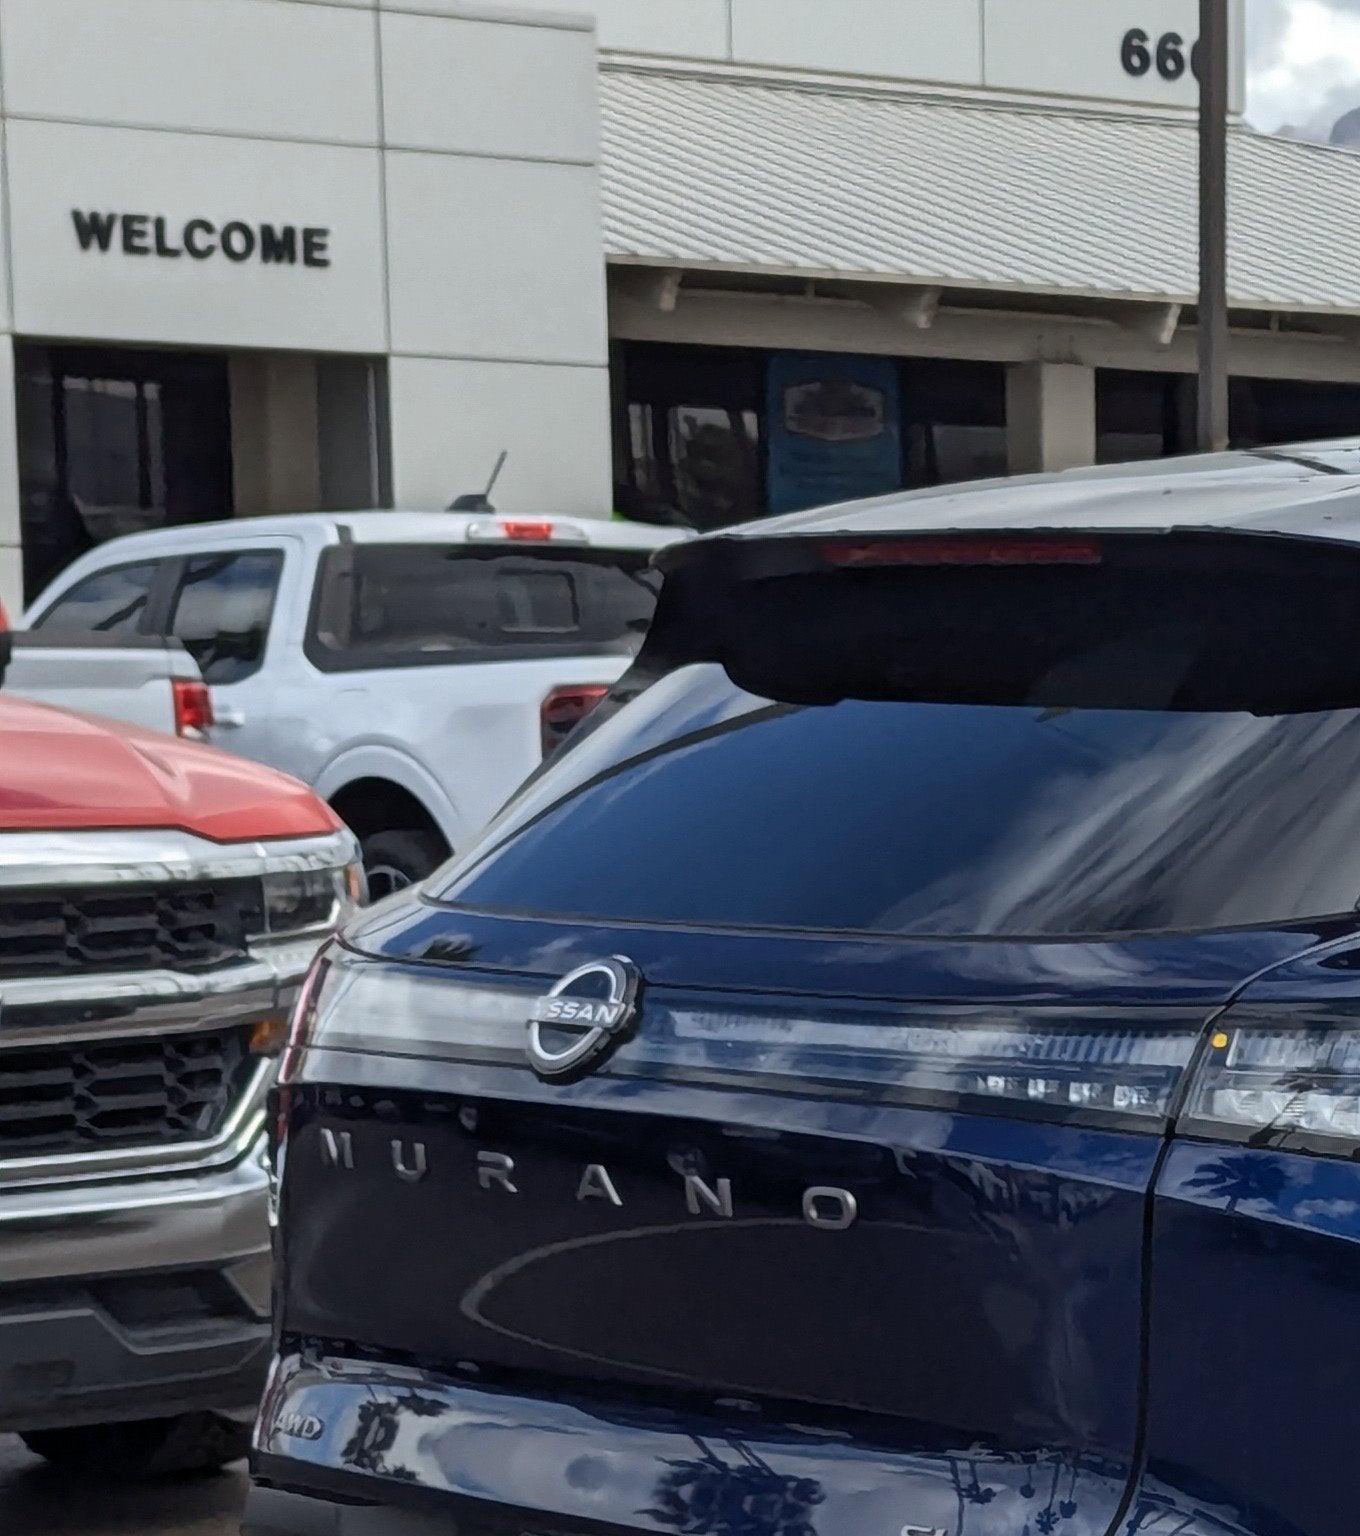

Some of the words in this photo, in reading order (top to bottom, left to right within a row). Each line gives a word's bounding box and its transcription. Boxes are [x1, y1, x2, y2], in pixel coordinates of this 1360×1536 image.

[71, 208, 331, 268] WELCOME
[546, 1000, 620, 1024] SSAN
[319, 1127, 858, 1231] MURANO
